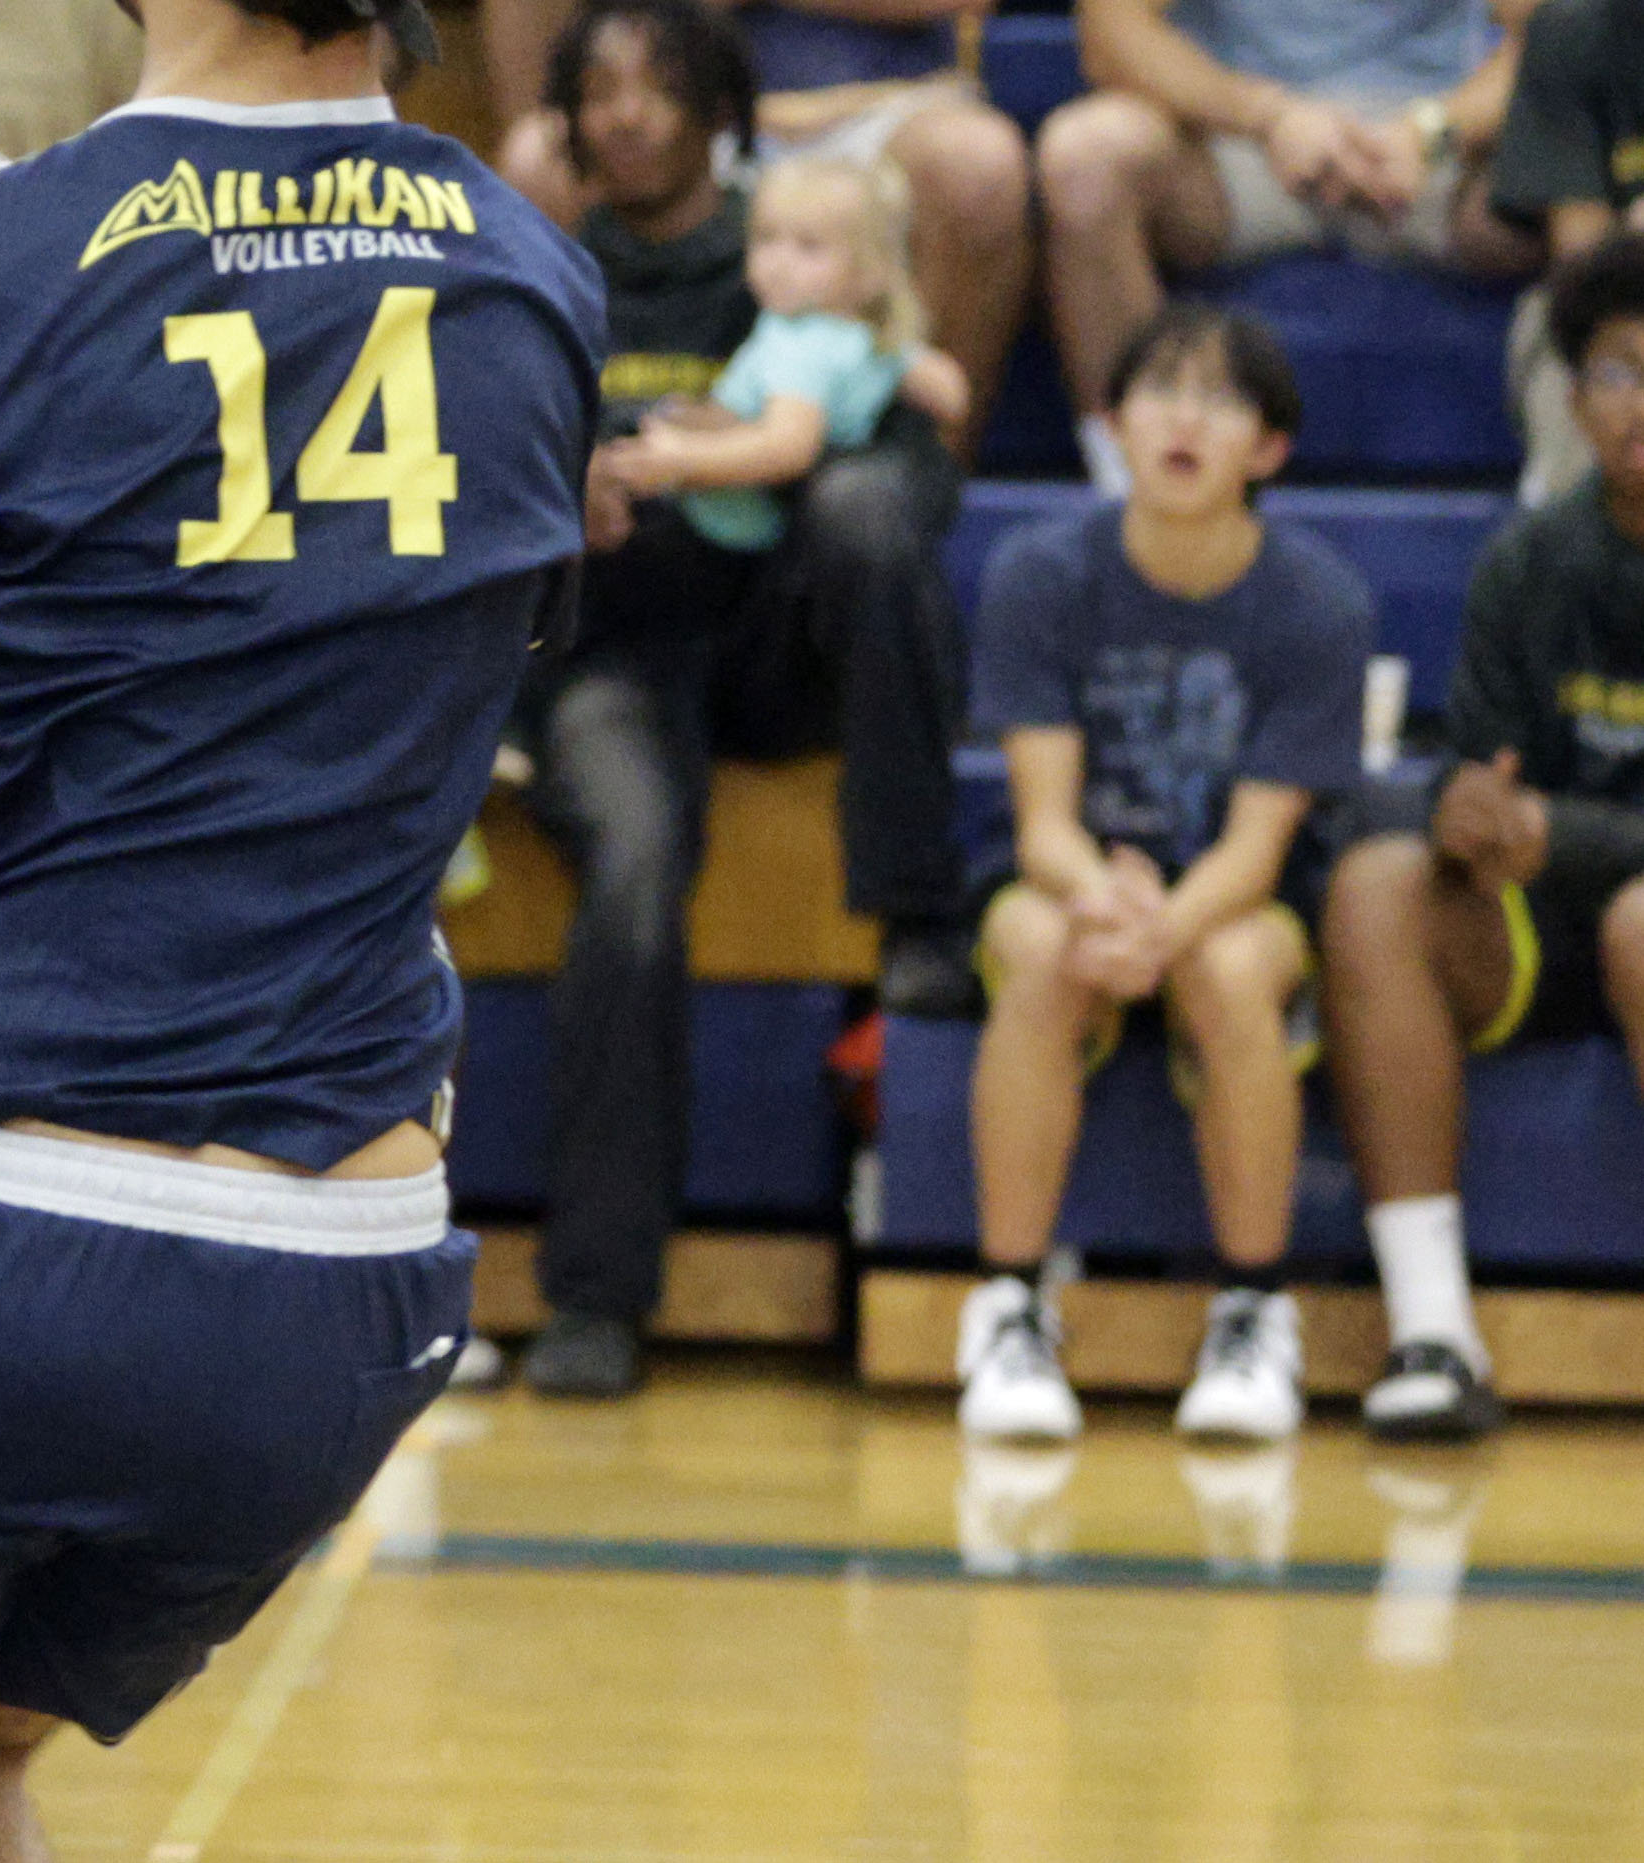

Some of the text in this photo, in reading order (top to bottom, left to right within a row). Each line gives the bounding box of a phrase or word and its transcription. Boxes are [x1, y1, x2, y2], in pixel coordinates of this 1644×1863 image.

[77, 158, 477, 271] MILLIKAN
[212, 229, 446, 275] VOLLEYBALL
[164, 287, 458, 567] 14
